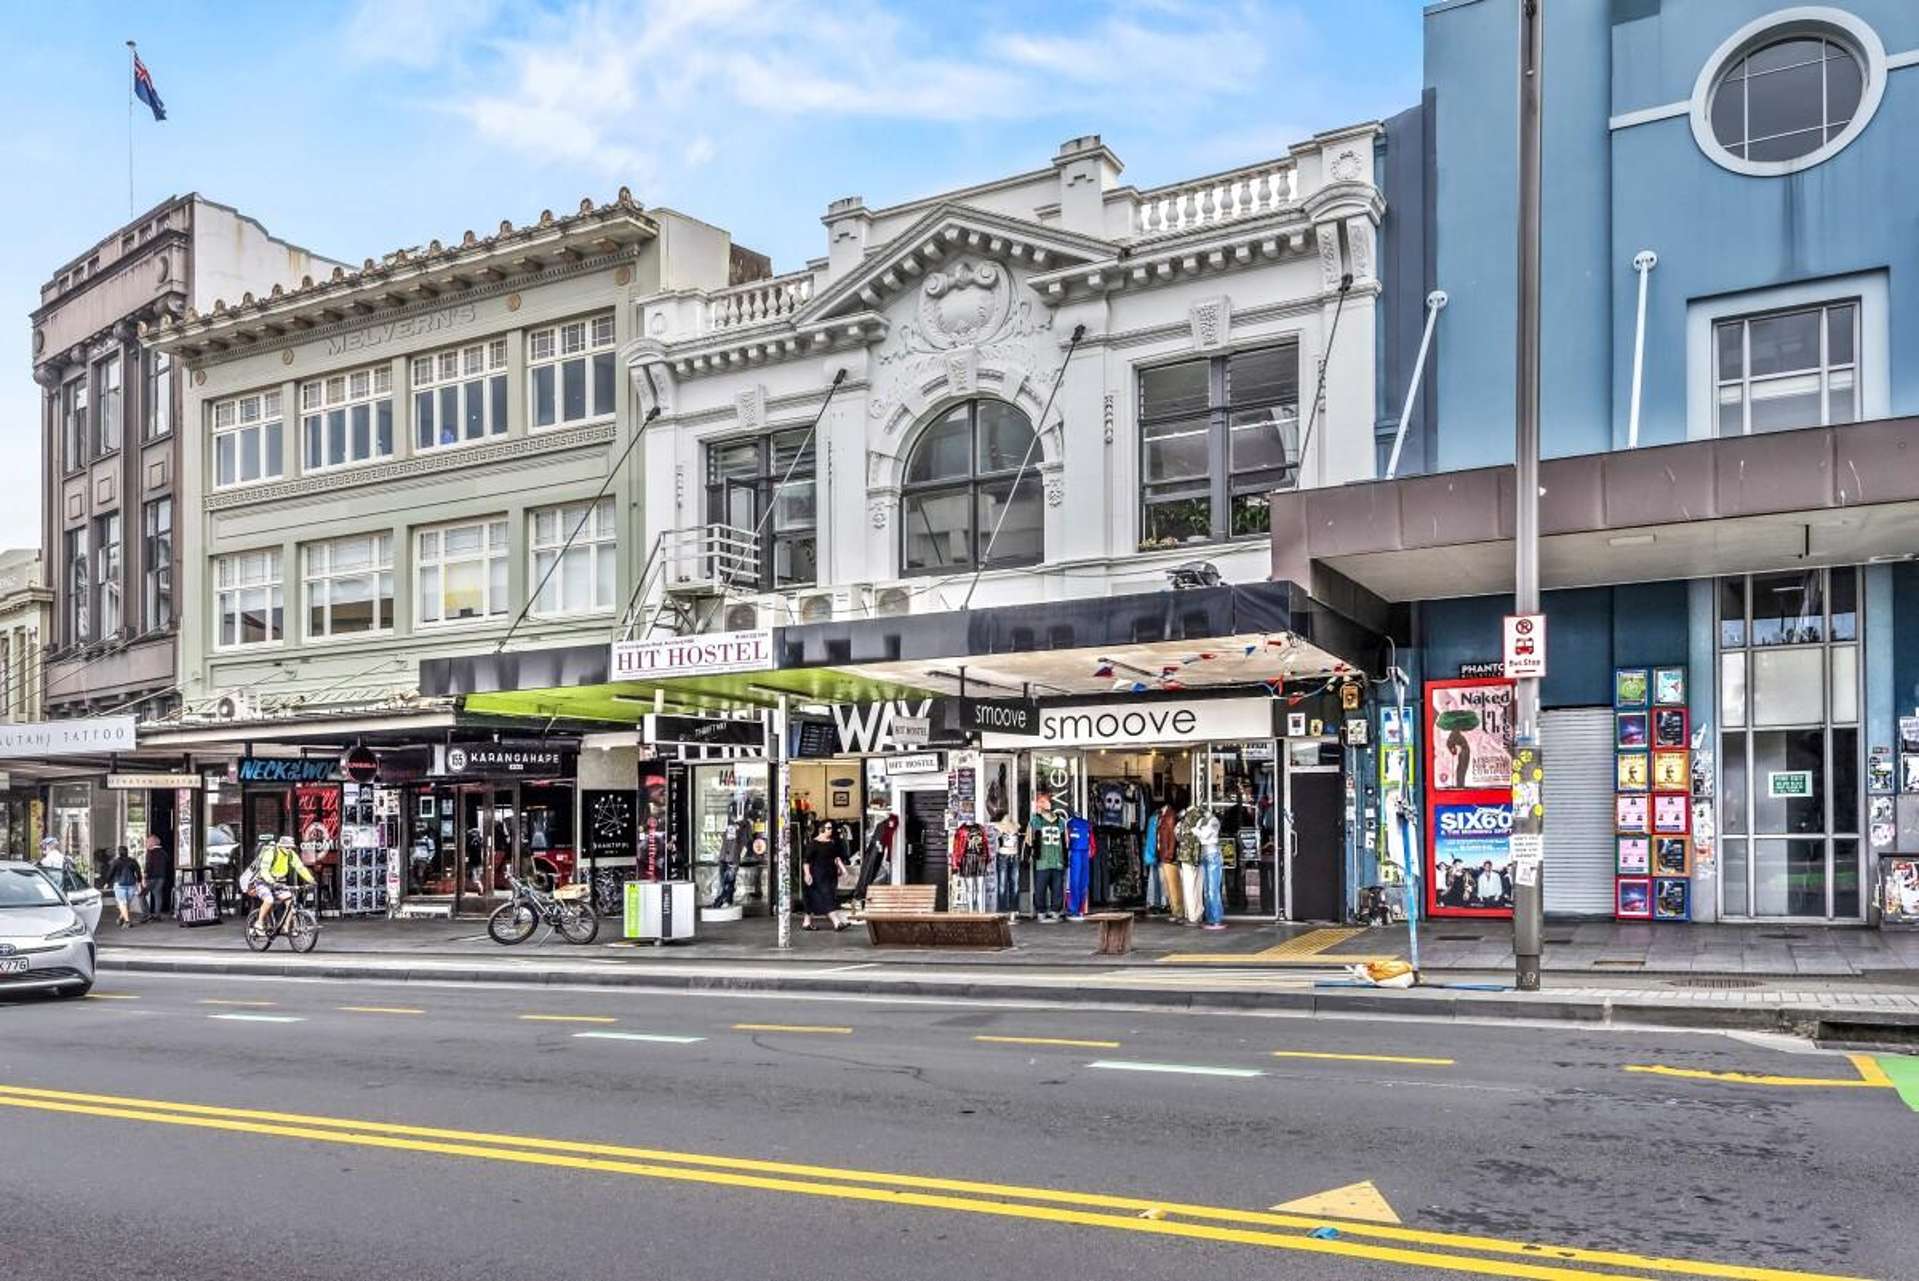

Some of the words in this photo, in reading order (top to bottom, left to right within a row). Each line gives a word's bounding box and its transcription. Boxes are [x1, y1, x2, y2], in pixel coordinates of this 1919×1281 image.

[617, 650, 660, 671] HIT
[669, 640, 769, 666] HOSTEL
[1523, 657, 1541, 666] Stop
[1461, 691, 1510, 706] Naked
[831, 698, 934, 753] WAY
[975, 704, 1026, 729] smoove
[1043, 709, 1197, 741] smoove
[64, 728, 124, 743] TATTOO
[471, 752, 560, 764] KARANGAHAPE
[889, 760, 903, 769] HIT
[905, 758, 936, 769] HOSTEL
[240, 760, 289, 780] NECK
[1440, 812, 1513, 829] SIX60
[1042, 826, 1061, 845] 52
